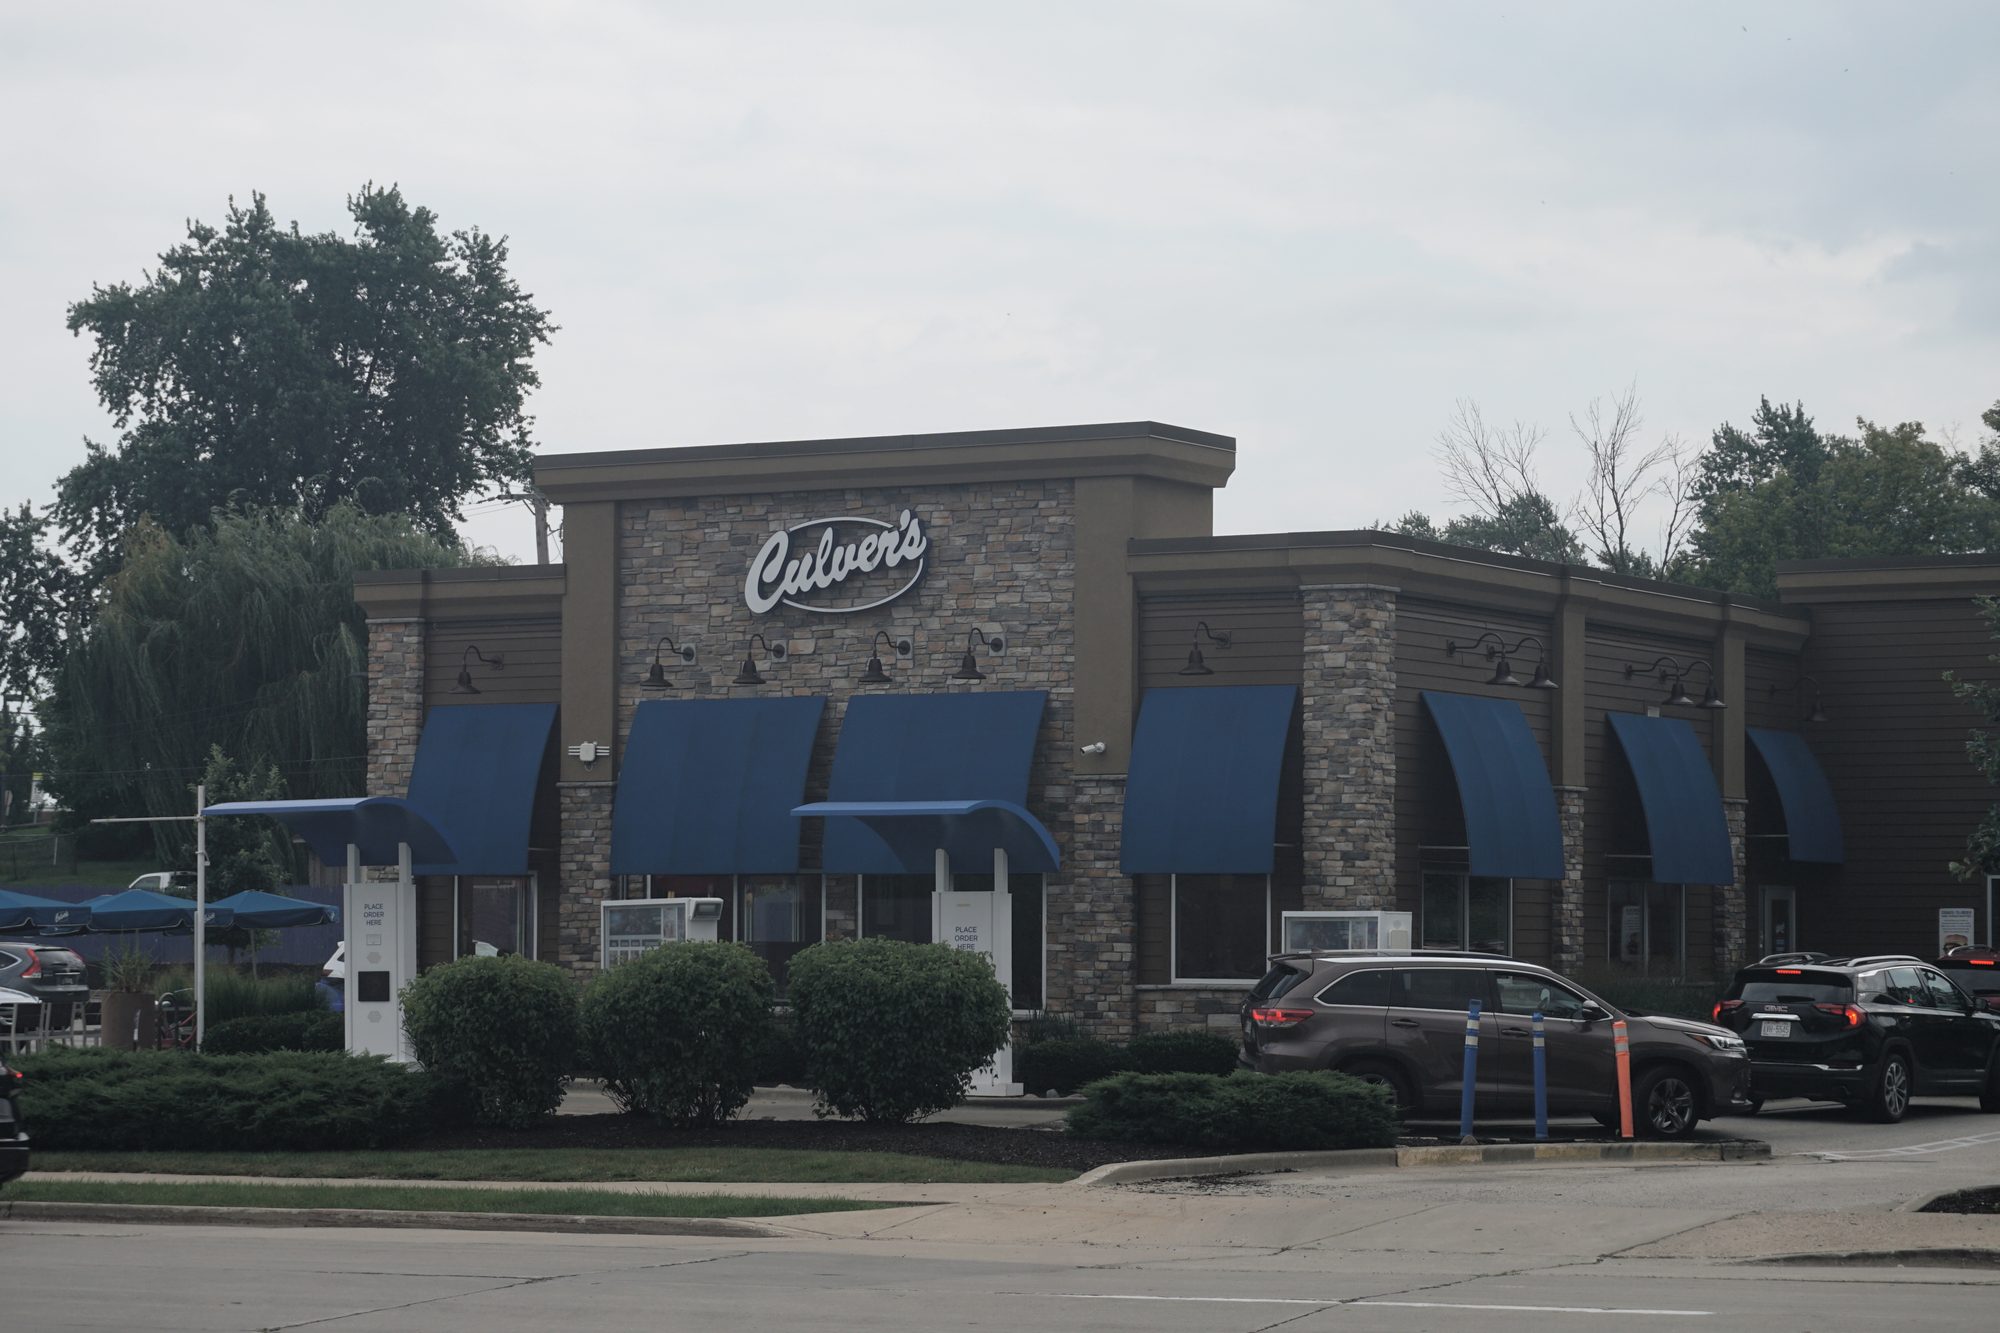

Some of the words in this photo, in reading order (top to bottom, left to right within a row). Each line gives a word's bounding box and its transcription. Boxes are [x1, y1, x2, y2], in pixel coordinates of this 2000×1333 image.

[744, 509, 927, 614] Culver's
[954, 934, 978, 942] ORDER
[1764, 1005, 1788, 1013] GMC
